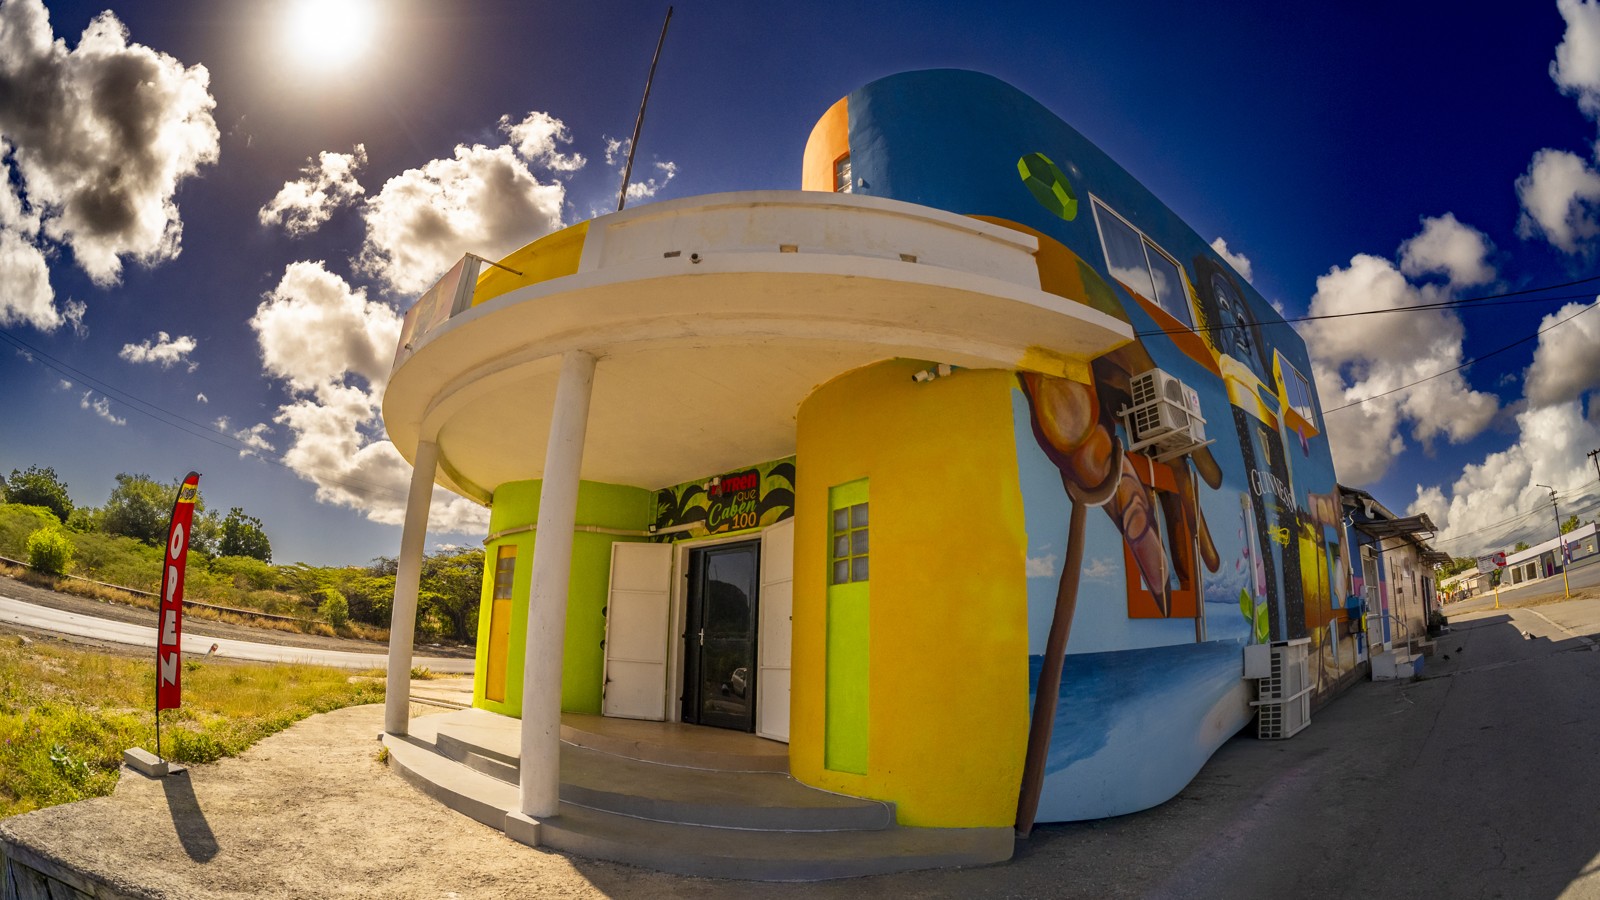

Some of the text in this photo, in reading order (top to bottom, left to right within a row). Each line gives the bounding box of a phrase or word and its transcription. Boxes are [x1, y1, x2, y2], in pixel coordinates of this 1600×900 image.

[737, 489, 756, 504] que
[708, 495, 756, 527] Caben
[732, 511, 757, 529] 100
[160, 522, 184, 688] OPEN
